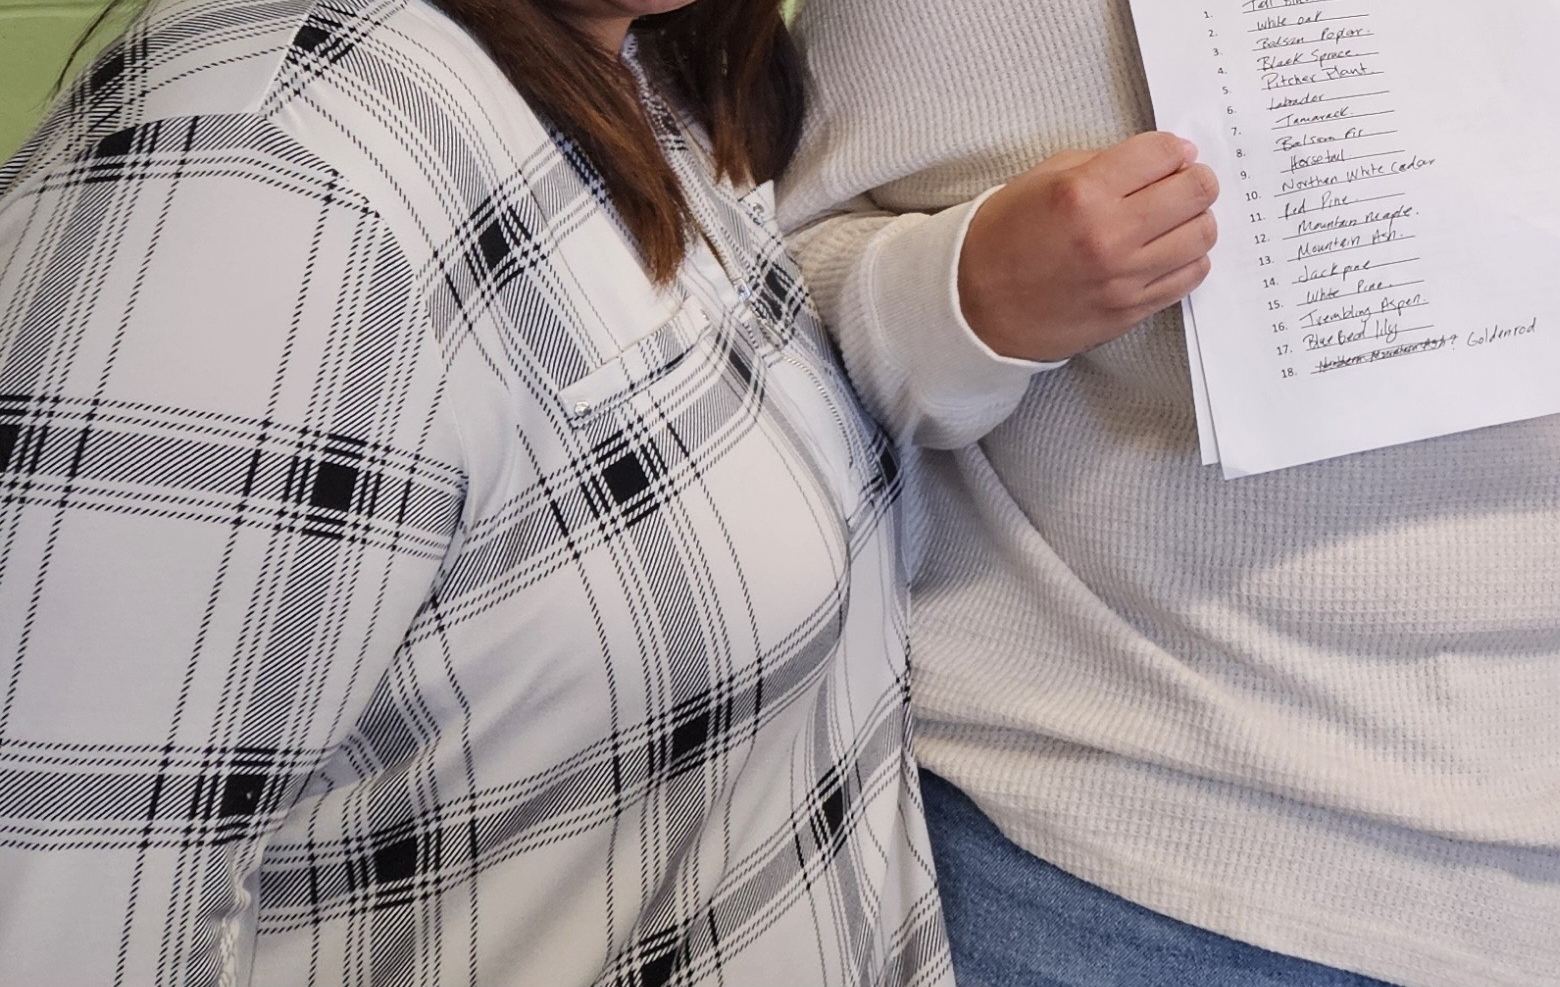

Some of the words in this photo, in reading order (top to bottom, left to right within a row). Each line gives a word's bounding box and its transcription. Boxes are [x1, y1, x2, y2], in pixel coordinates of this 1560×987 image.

[1208, 29, 1218, 38] 2.
[1213, 48, 1223, 56] 3.
[1217, 67, 1227, 75] 4.
[1222, 87, 1232, 95] 5.
[1226, 106, 1237, 114] 6.
[1231, 127, 1241, 136] 7.
[1236, 148, 1246, 157] 8.
[1240, 170, 1250, 180] 9.
[1245, 191, 1261, 201] 10.
[1250, 213, 1266, 223] 11.
[1254, 234, 1270, 244] 12.
[1259, 256, 1274, 266] 13.
[1263, 278, 1279, 288] 14.
[1268, 300, 1283, 311] 15.
[1272, 323, 1288, 333] 16.
[1277, 345, 1293, 355] 17.
[1281, 368, 1297, 378] 18.
[1466, 316, 1537, 347] Goldenrod
